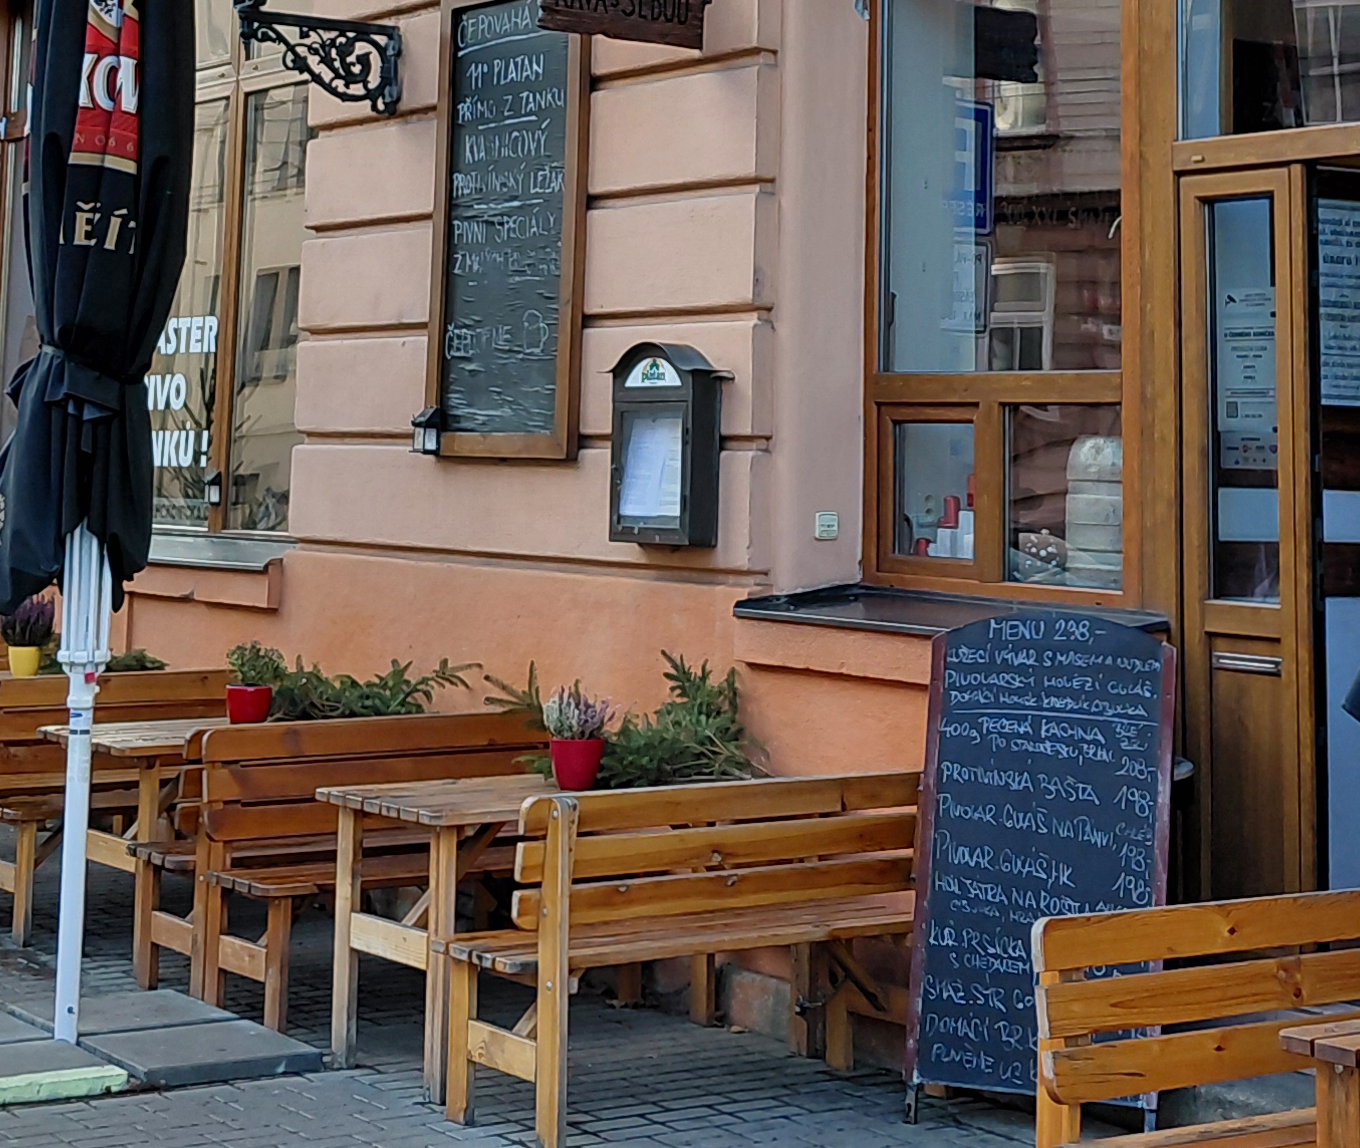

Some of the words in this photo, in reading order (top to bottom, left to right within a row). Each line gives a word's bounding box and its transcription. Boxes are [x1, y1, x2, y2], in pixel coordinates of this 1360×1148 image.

[492, 53, 544, 86] PLATAN
[503, 94, 515, 117] Z
[518, 87, 565, 115] TANKU
[157, 315, 218, 354] ASTER
[145, 372, 187, 411] IVO
[152, 421, 196, 467] NKŮ
[988, 618, 1045, 641] MENU
[939, 718, 982, 746] 400g
